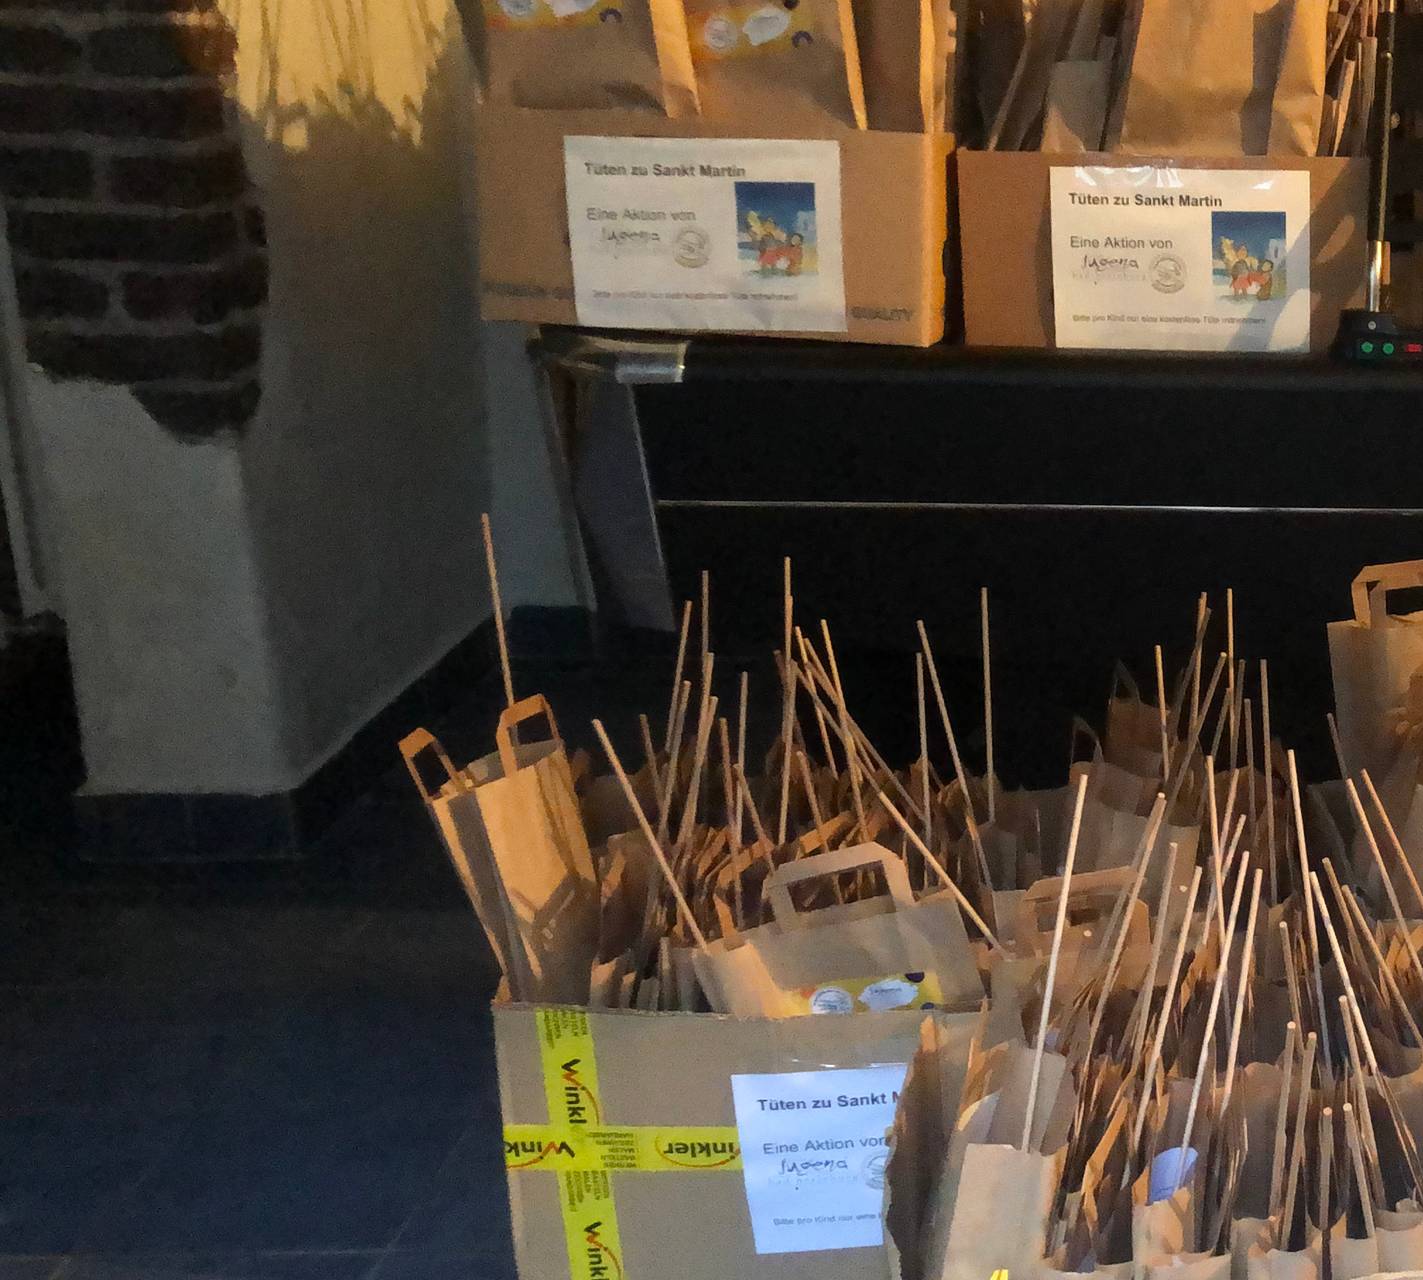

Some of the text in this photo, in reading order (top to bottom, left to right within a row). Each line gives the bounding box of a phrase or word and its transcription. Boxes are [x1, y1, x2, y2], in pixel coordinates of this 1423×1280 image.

[631, 165, 647, 176] zu
[652, 164, 695, 177] Sankt
[700, 165, 746, 178] Martin
[1068, 192, 1222, 207] Tüten zu Sankt Martin
[586, 207, 617, 221] Eine
[1070, 236, 1173, 249] Eine Aktion von
[758, 1098, 807, 1111] Tüten
[812, 1099, 831, 1109] zu
[837, 1093, 887, 1107] Sankt
[763, 1141, 799, 1154] Eine
[805, 1138, 854, 1151] Aktion
